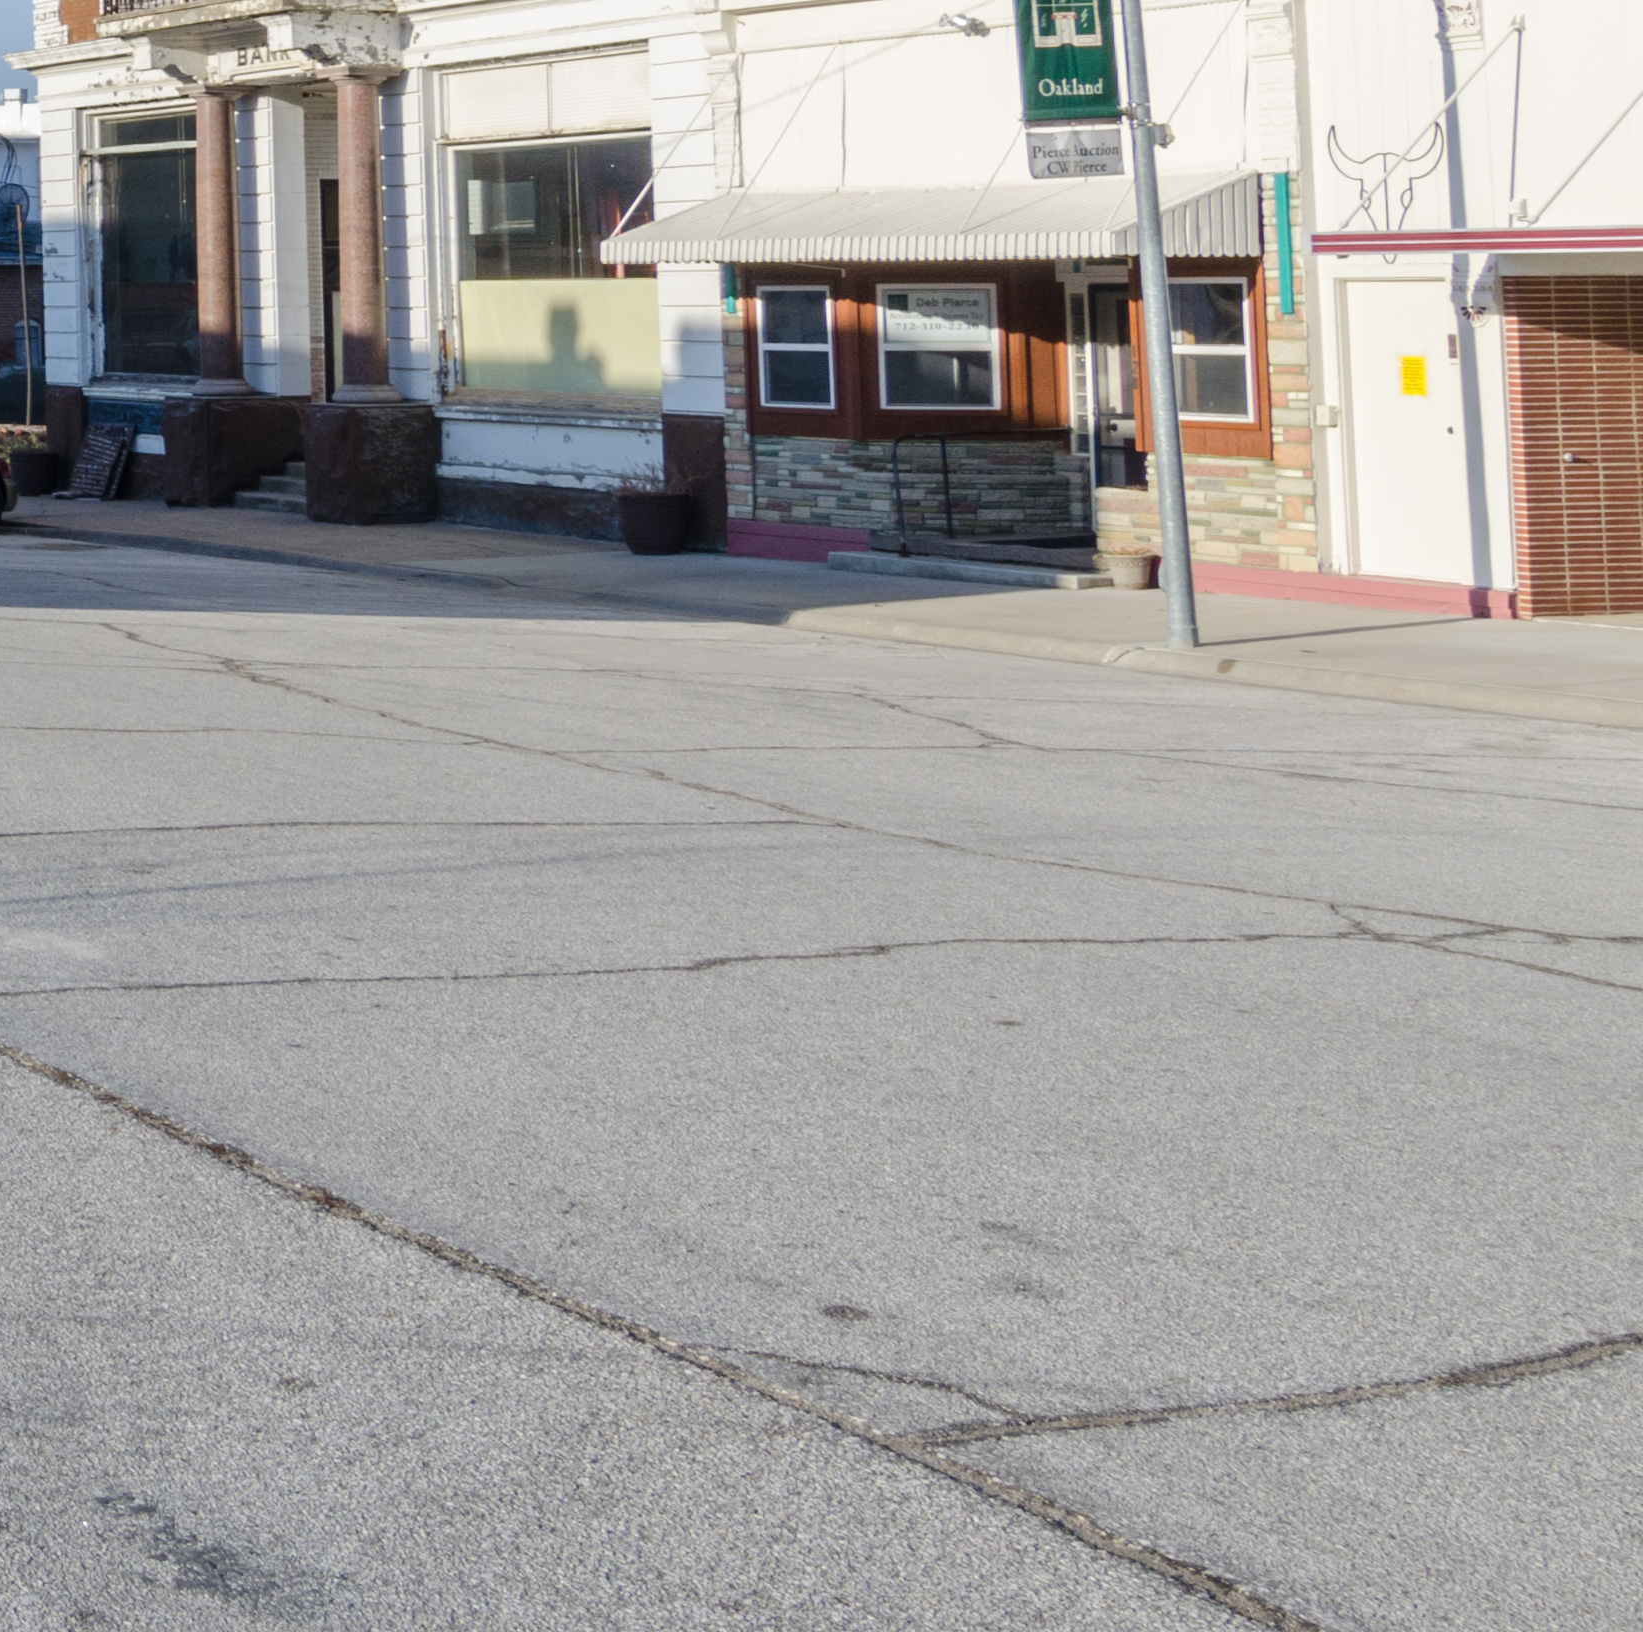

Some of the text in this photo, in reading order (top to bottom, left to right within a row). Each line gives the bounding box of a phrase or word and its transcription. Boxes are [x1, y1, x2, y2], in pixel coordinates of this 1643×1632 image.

[1038, 77, 1103, 97] Oakland
[1032, 143, 1119, 159] Pierce Auction
[1047, 160, 1108, 175] CW Pierce
[916, 297, 939, 307] Deb
